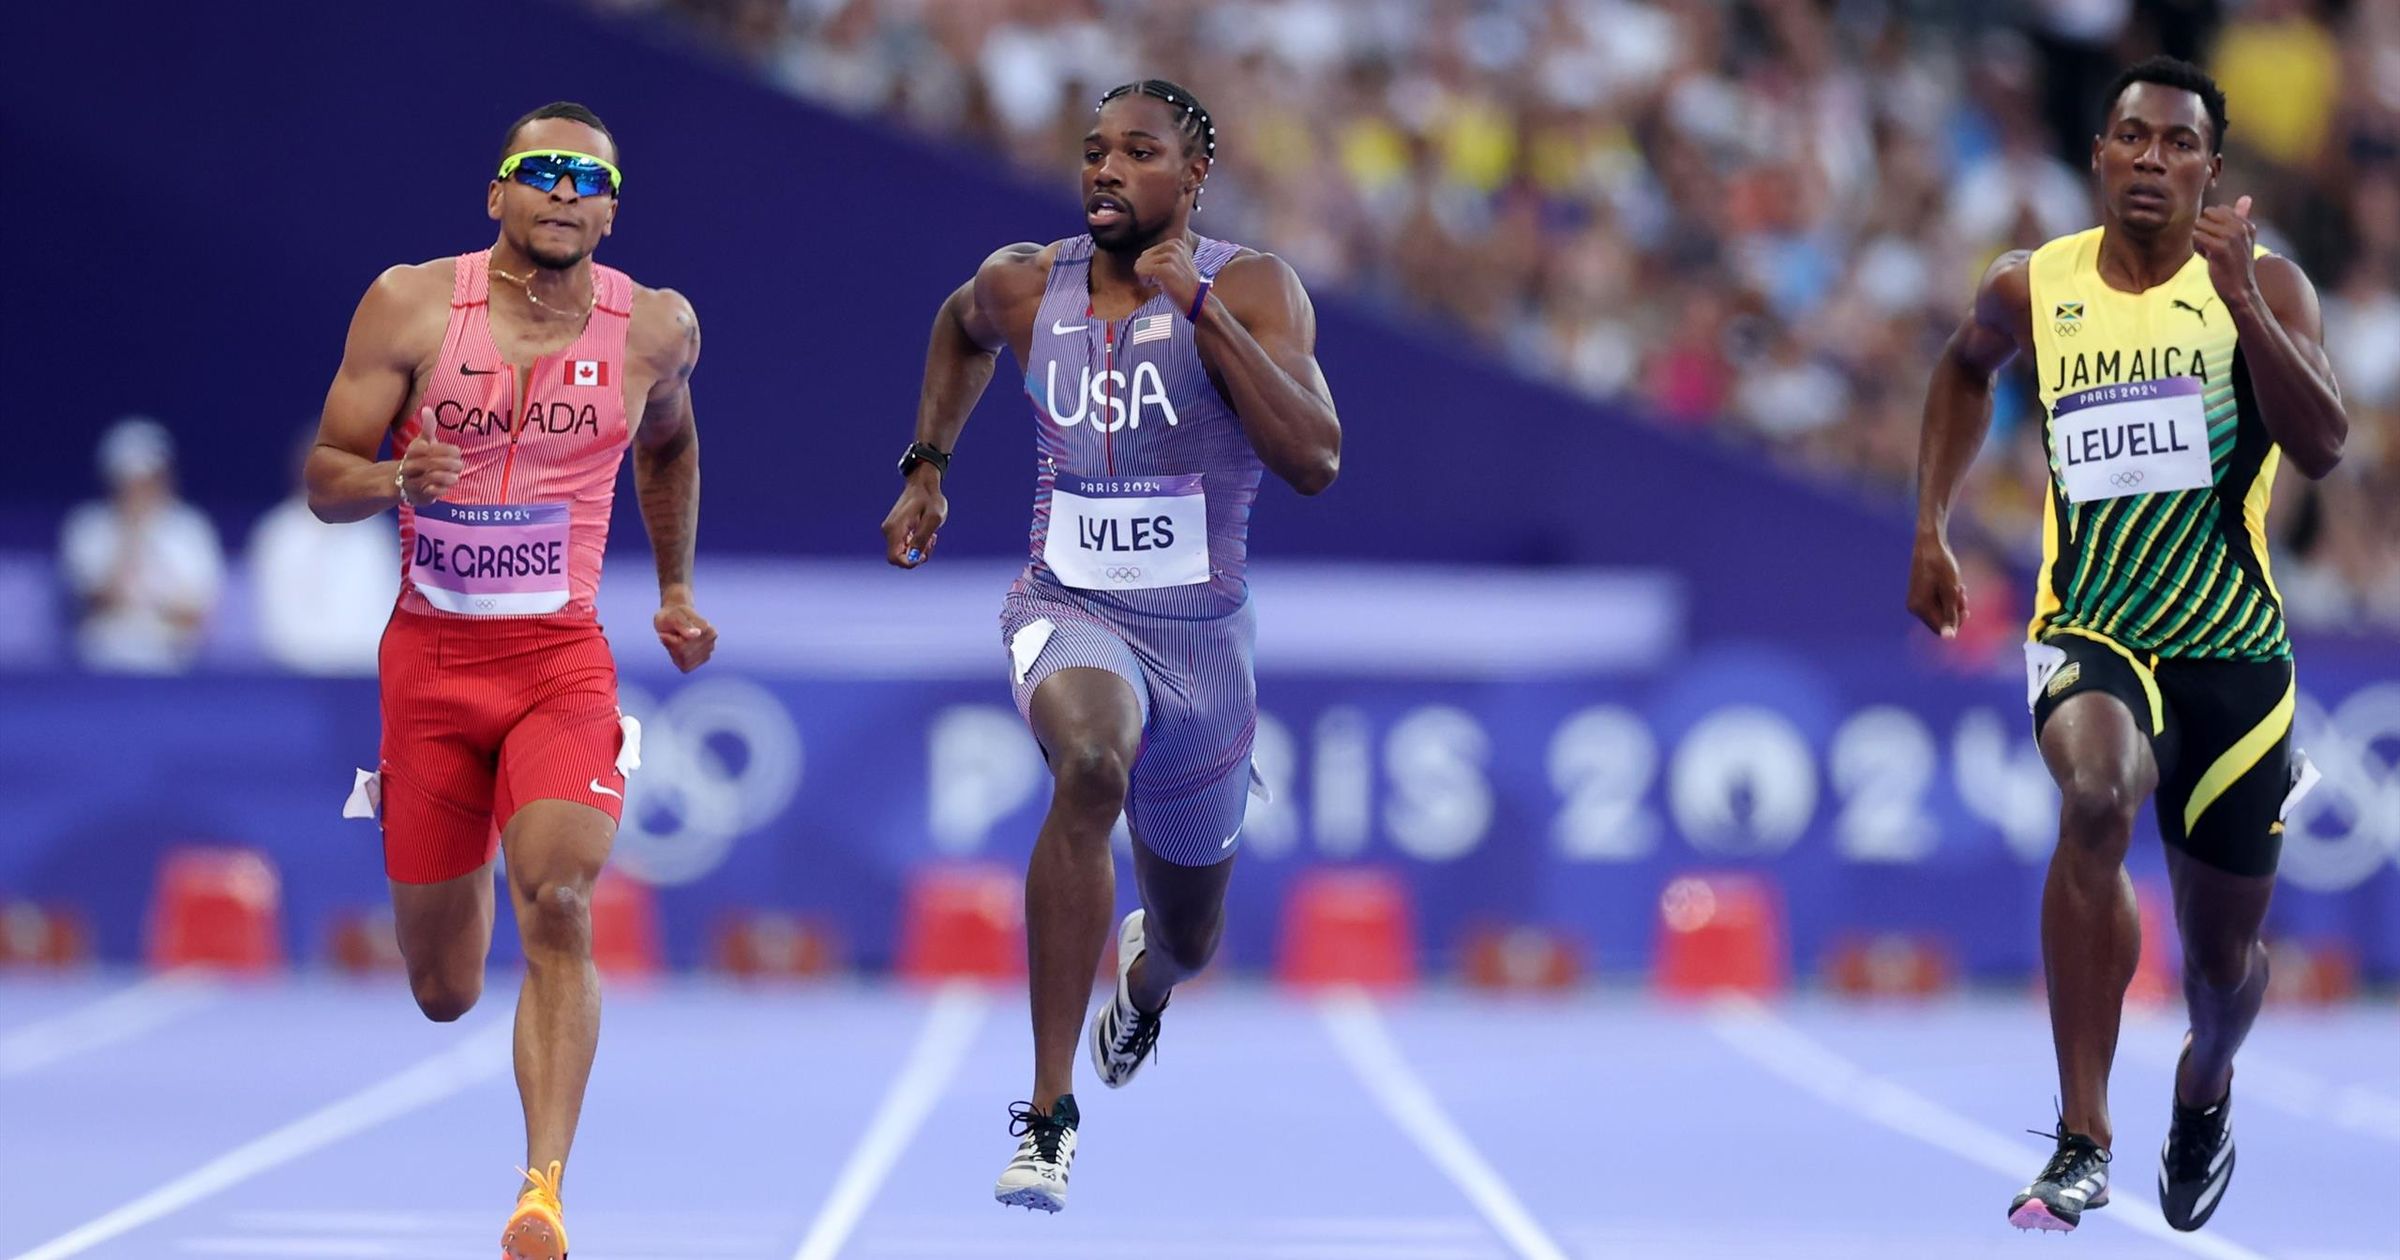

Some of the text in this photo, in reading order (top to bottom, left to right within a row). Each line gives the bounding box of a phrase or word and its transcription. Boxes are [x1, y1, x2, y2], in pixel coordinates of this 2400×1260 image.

[2053, 346, 2208, 392] JAMAICA
[1047, 360, 1178, 433] USA
[2080, 384, 2158, 404] PARIS 2024
[435, 400, 599, 437] CANADA
[2066, 419, 2189, 467] LEVELL
[1080, 481, 1160, 493] PARIS 2024
[451, 508, 530, 521] PARIS 2024
[1078, 514, 1175, 552] LYLES
[415, 533, 563, 578] DE GRASSE
